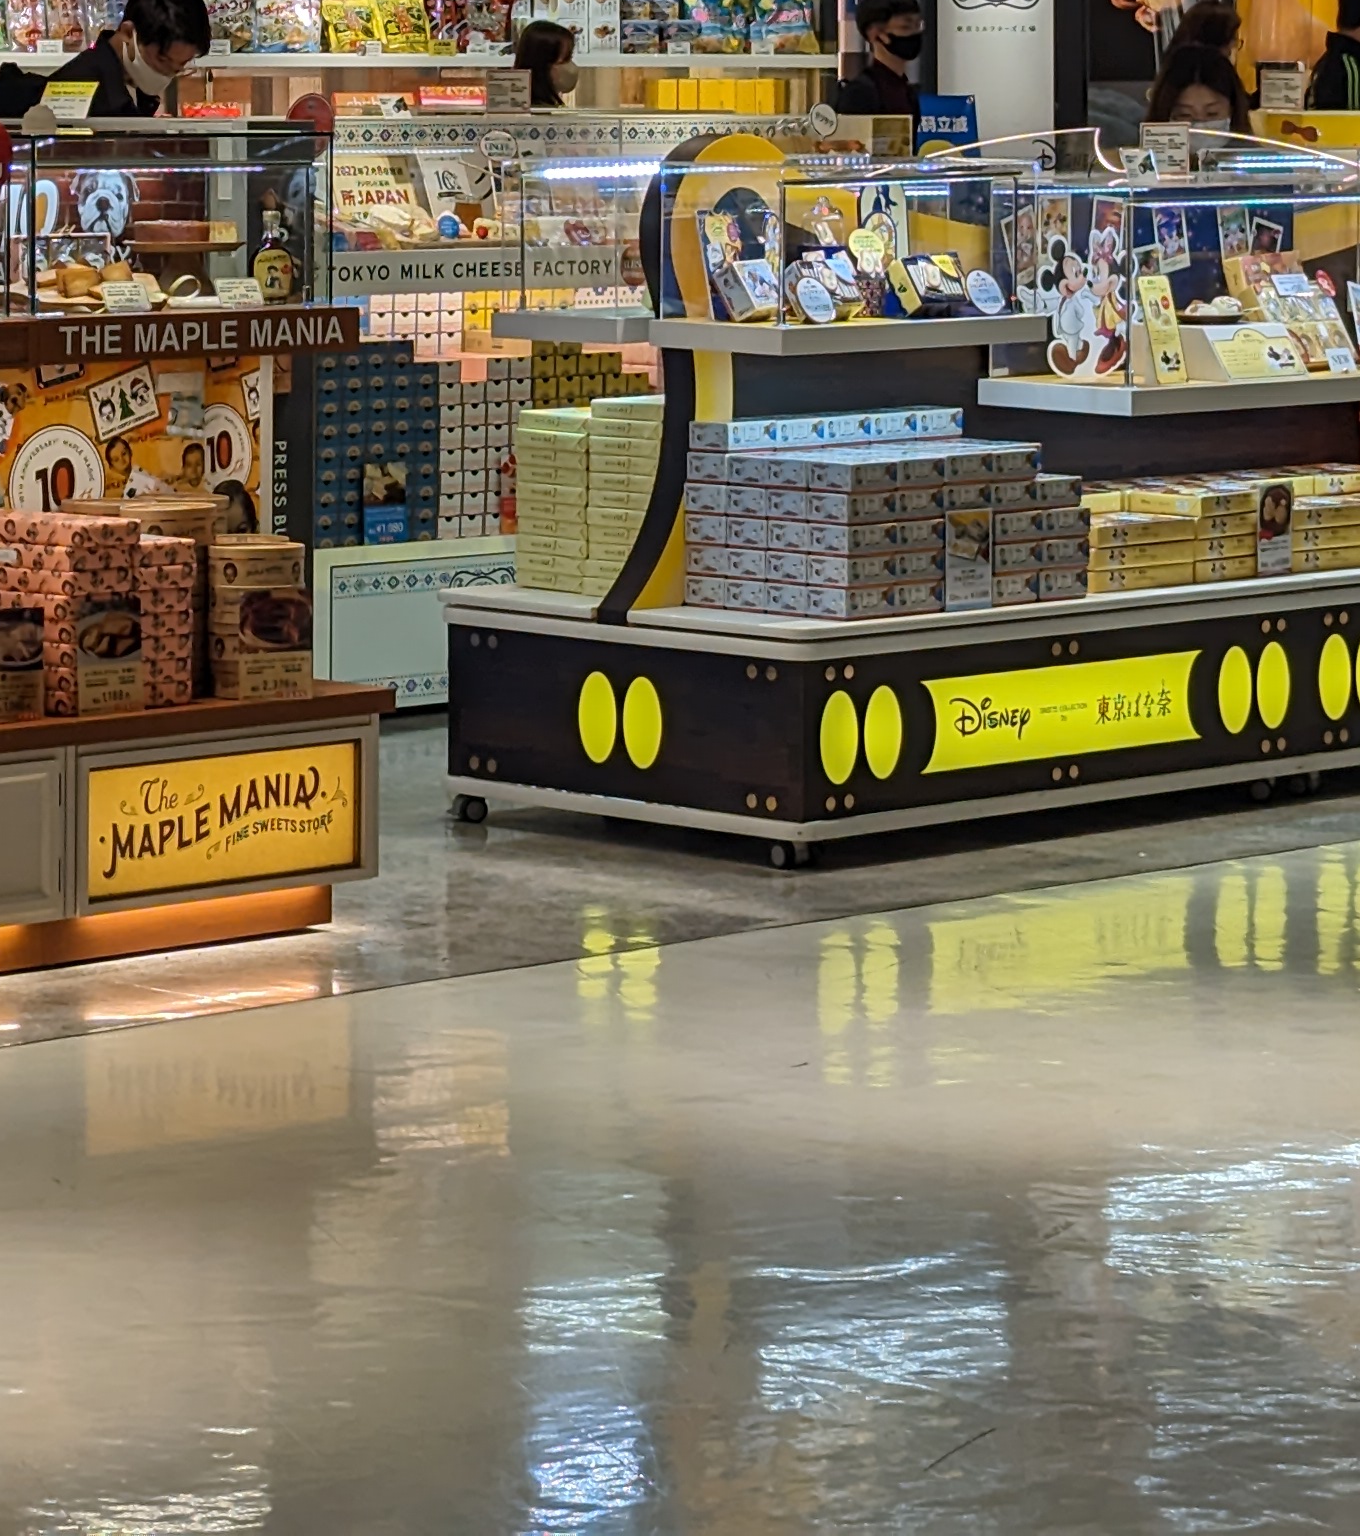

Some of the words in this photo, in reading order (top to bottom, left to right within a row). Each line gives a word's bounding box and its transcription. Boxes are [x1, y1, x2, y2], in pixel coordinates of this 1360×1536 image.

[400, 263, 445, 280] MILK
[452, 261, 525, 279] CHEESE
[533, 258, 613, 276] FACTORY
[59, 324, 123, 357] THE
[134, 319, 238, 354] MAPLE
[249, 314, 344, 348] MANIA
[35, 457, 75, 512] 10
[274, 440, 288, 510] PRESS
[950, 695, 1031, 741] Disney
[139, 777, 179, 814] The
[102, 803, 211, 879] MAPLE
[218, 766, 321, 828] MANIA
[251, 818, 297, 836] SWEETS
[298, 808, 335, 834] STORE
